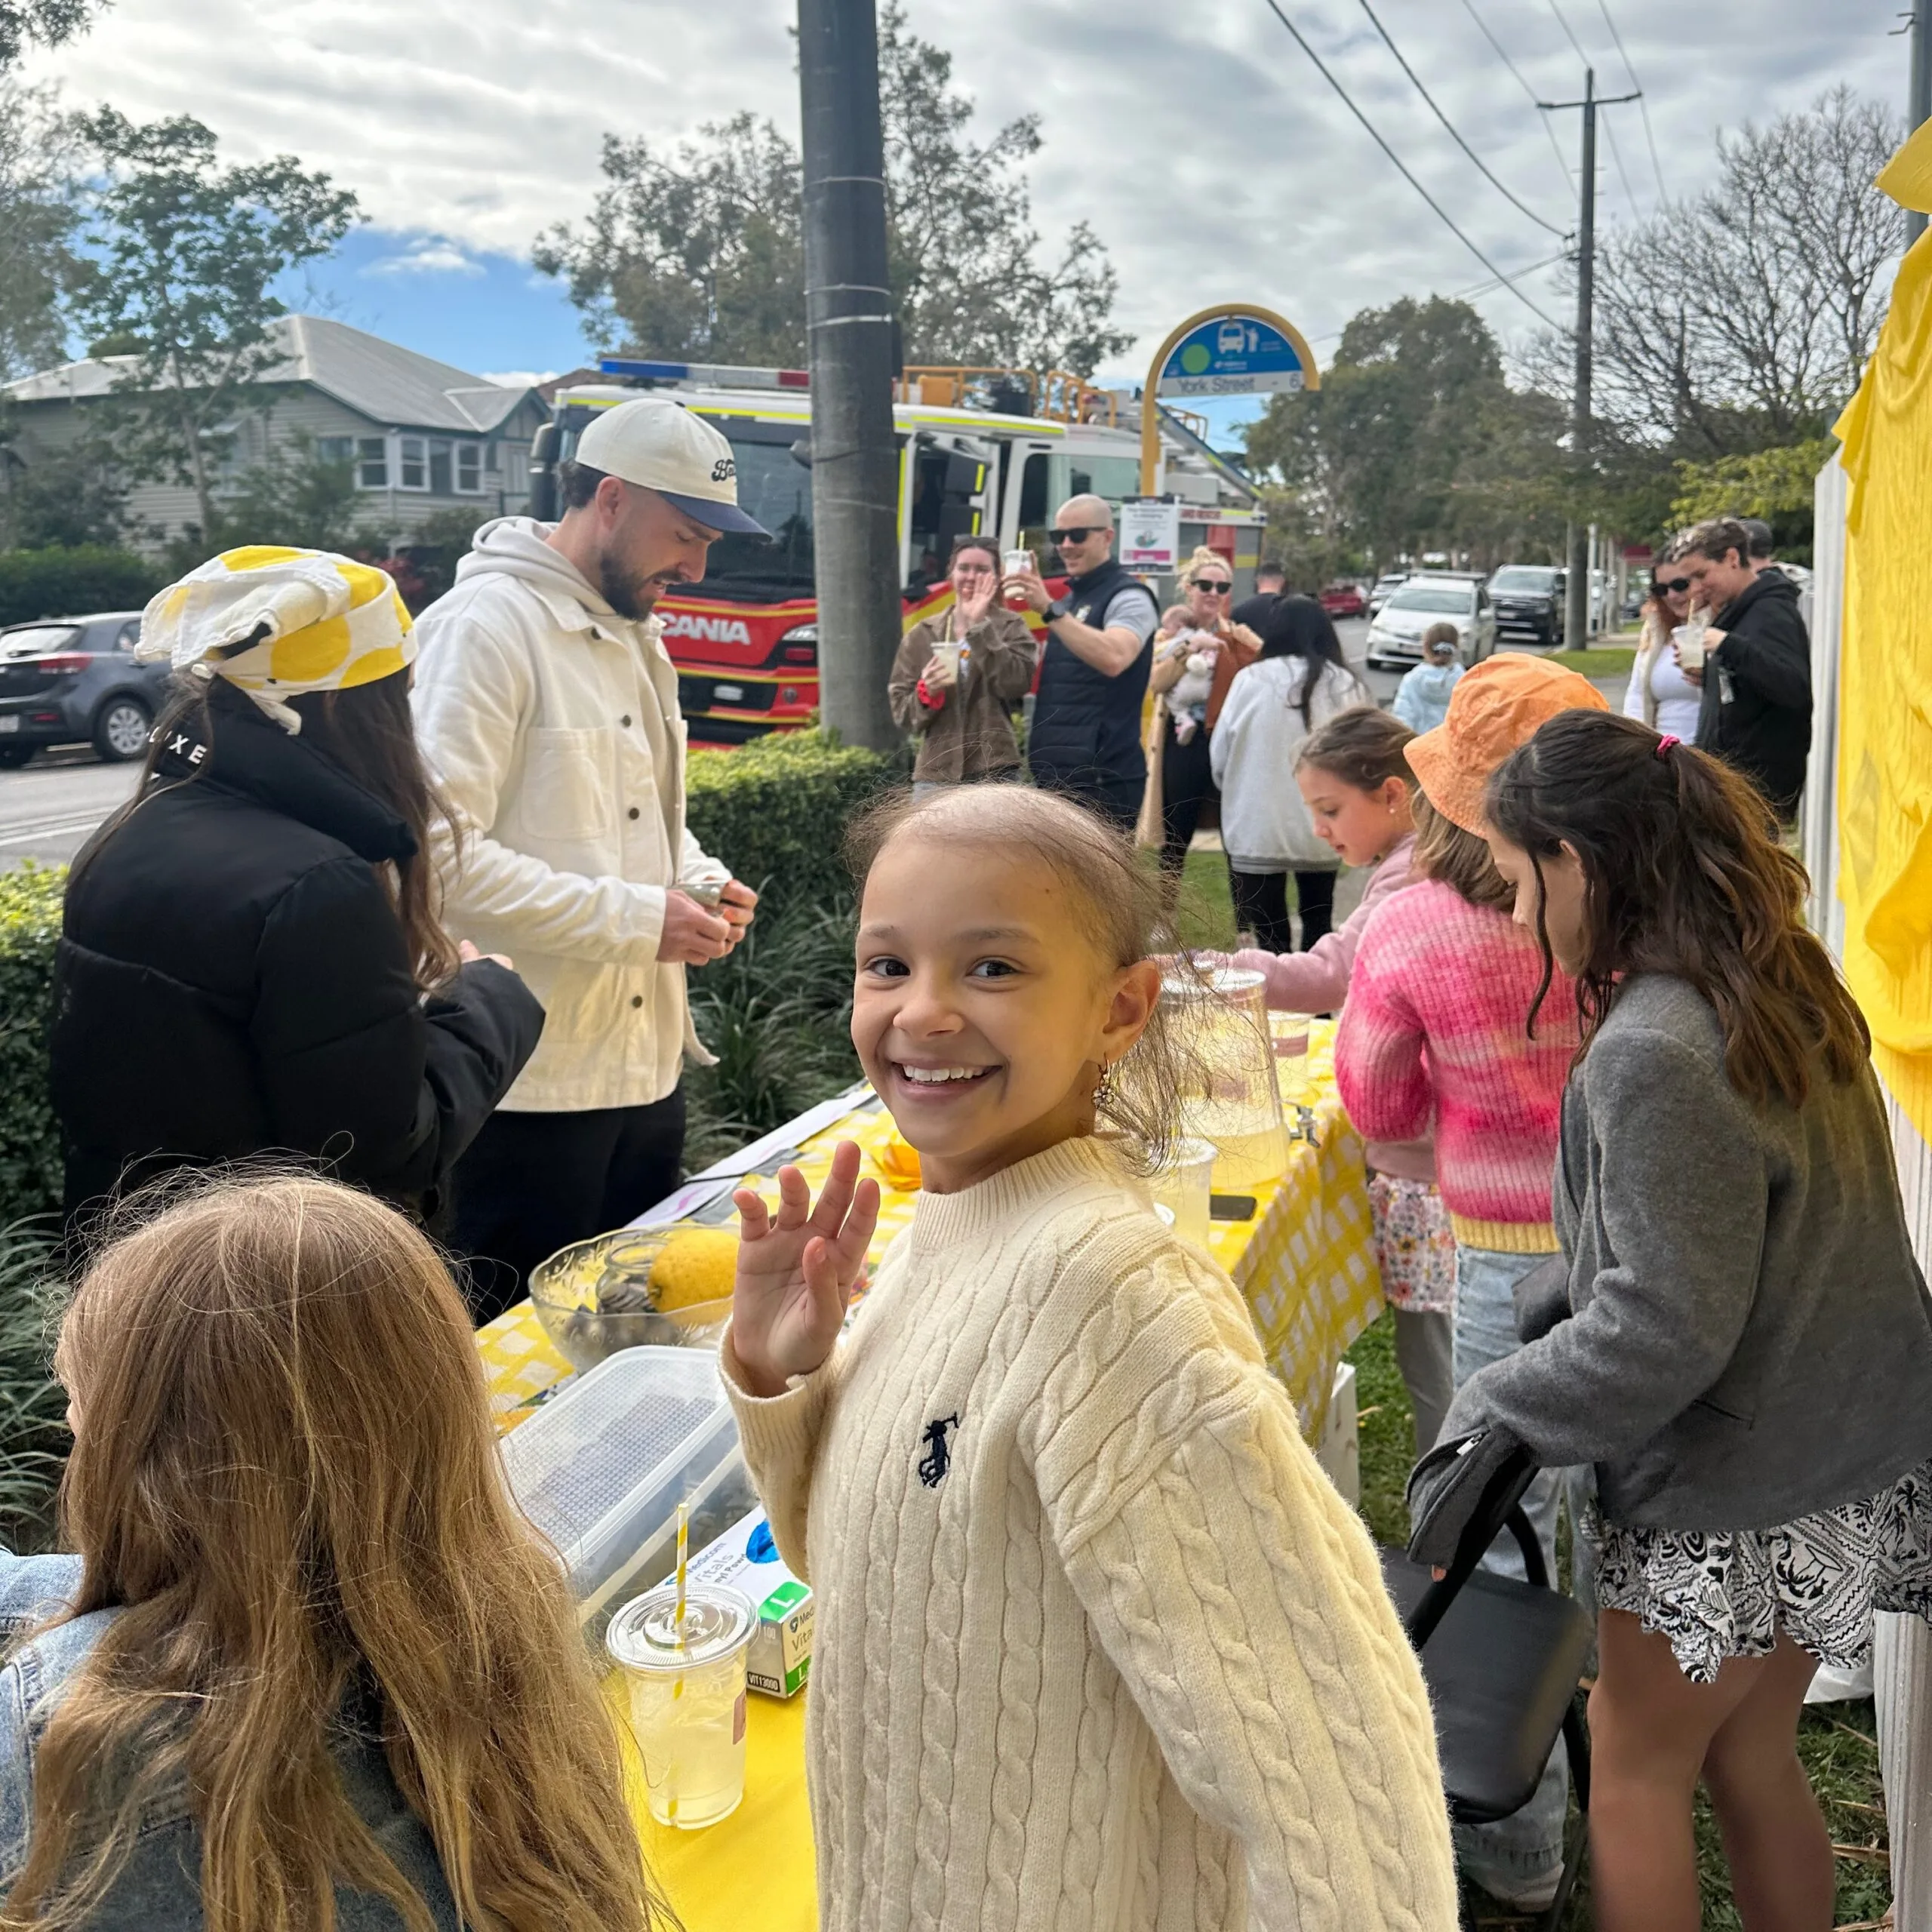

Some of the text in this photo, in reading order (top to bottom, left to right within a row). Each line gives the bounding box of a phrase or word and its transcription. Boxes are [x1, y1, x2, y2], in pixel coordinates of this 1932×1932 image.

[1177, 377, 1208, 393] York
[1212, 377, 1254, 392] Street
[1289, 373, 1300, 388] 6
[658, 611, 751, 645] CANIA
[770, 1597, 796, 1608] L
